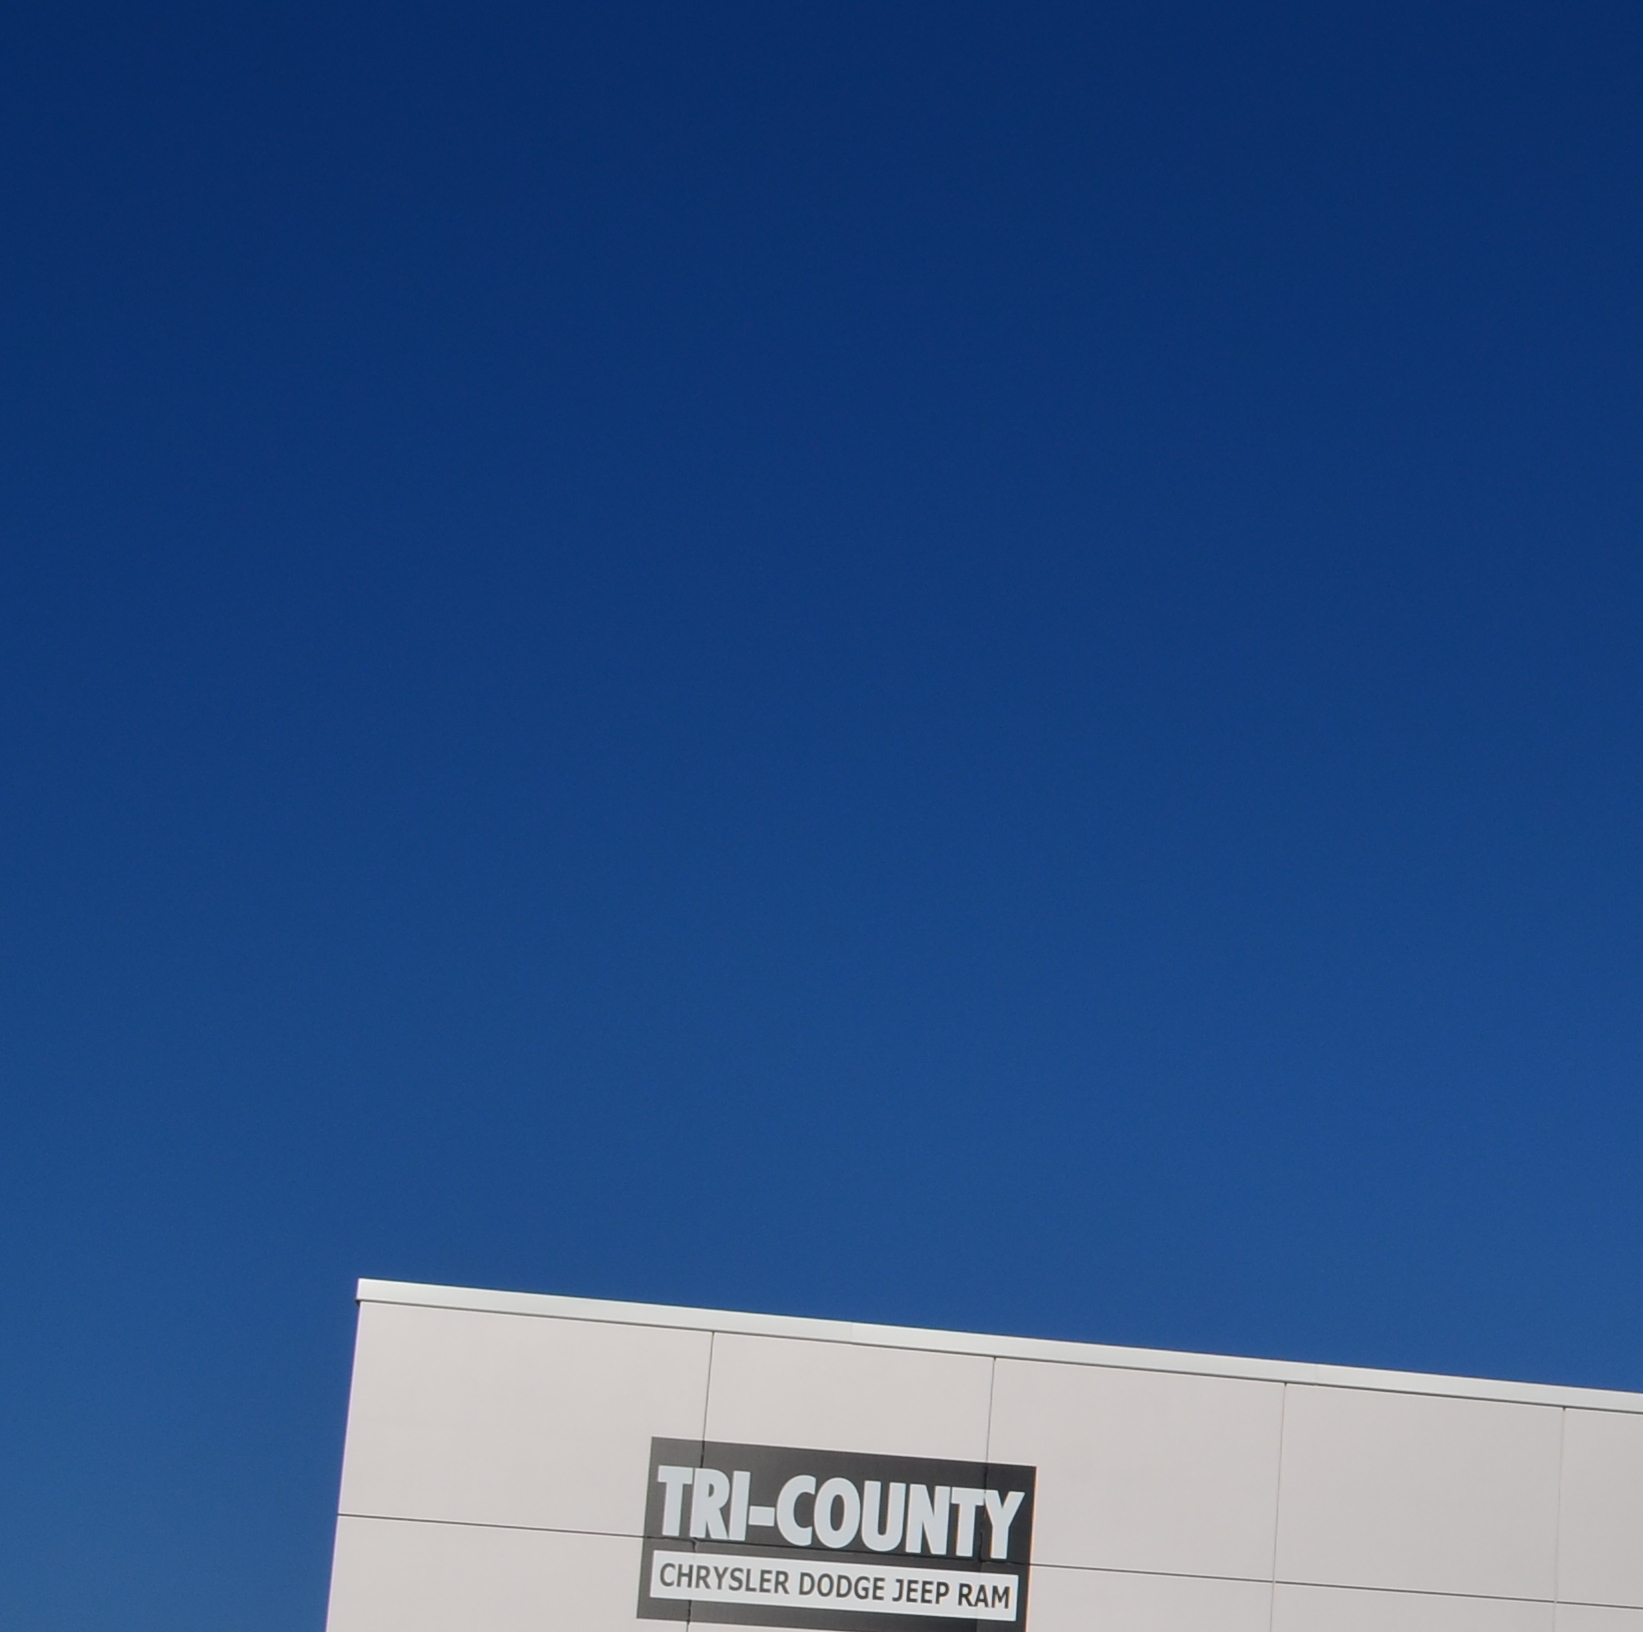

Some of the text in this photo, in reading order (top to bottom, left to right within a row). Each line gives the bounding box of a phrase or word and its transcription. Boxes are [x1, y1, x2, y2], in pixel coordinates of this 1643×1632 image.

[657, 1465, 1025, 1560] TRI-COUNTY
[659, 1562, 1011, 1610] CHRYSLER DODGE JEEP RAM
